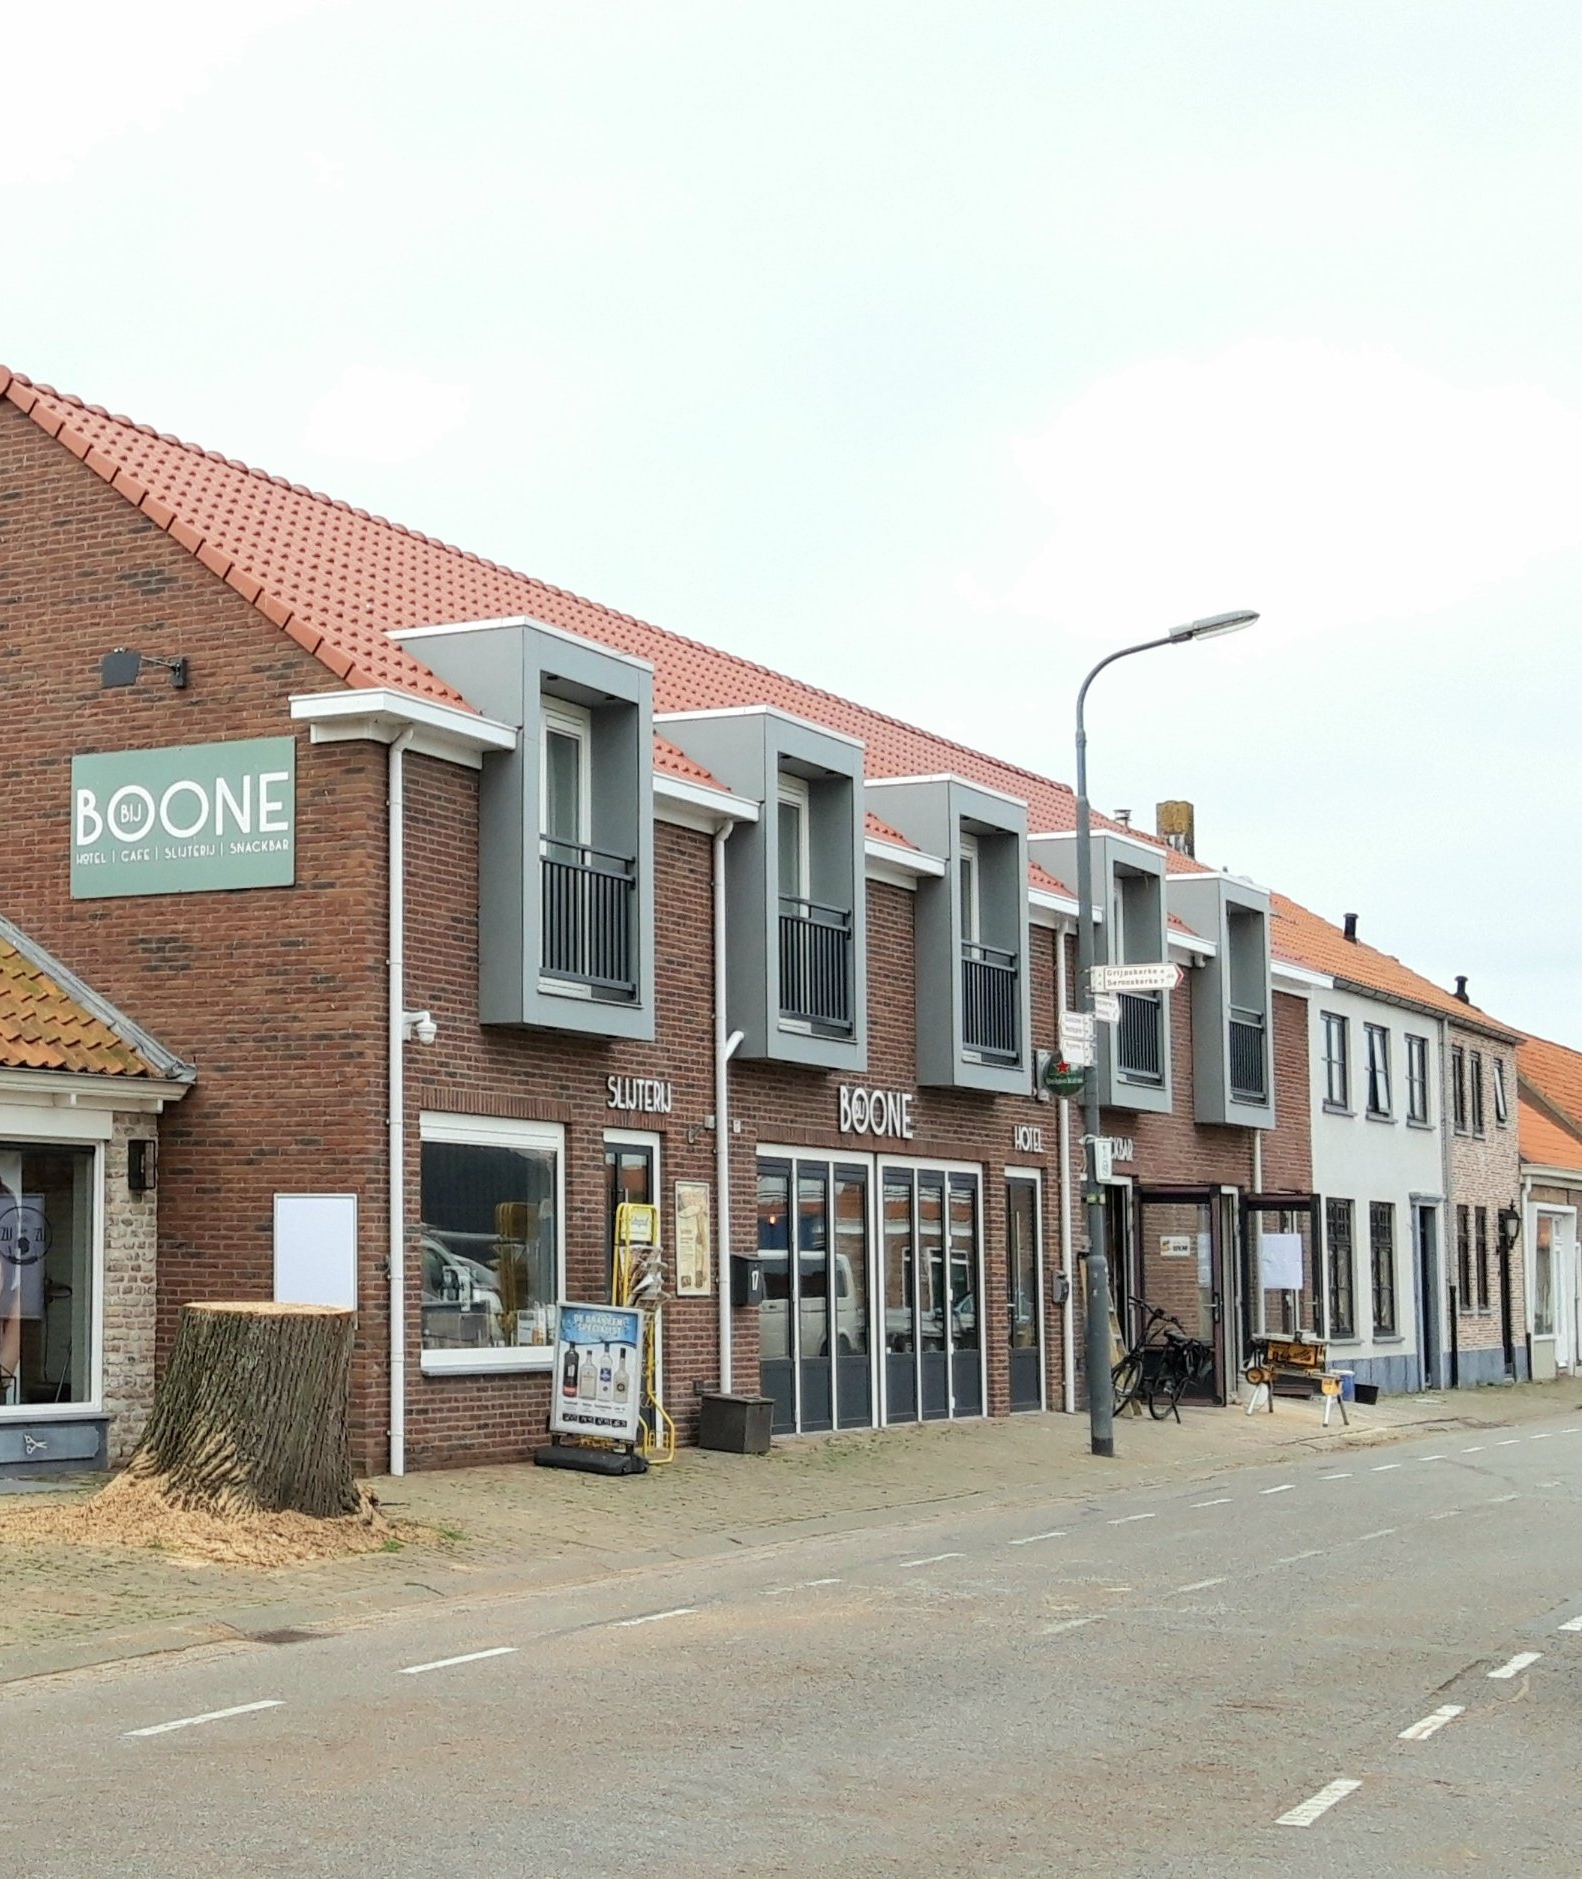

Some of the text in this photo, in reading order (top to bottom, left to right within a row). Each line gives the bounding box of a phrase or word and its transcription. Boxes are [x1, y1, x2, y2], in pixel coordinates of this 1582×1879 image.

[76, 771, 289, 846] BOONE
[120, 803, 141, 823] BIJ
[76, 852, 106, 865] HOTEL
[164, 843, 215, 860] SLIJTERIJ
[229, 839, 289, 854] SNACKBAR
[1107, 968, 1157, 978] Grijpskerke
[607, 1075, 671, 1113] SLIJTERIJ
[840, 1085, 914, 1139] BOONE
[1014, 1125, 1043, 1152] HOTEL
[751, 1270, 759, 1291] 17
